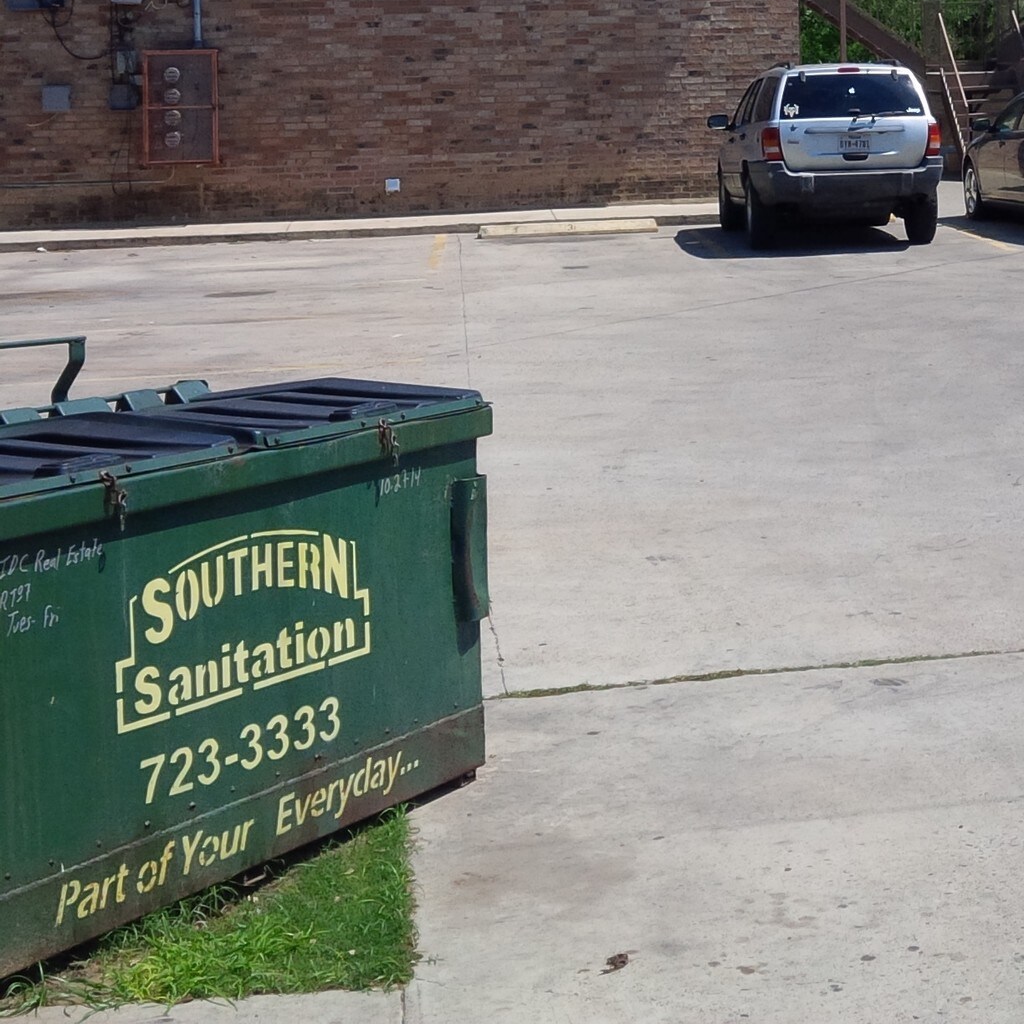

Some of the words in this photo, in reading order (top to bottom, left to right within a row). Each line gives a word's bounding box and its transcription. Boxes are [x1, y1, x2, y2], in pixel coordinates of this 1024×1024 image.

[34, 549, 61, 573] Real
[65, 537, 103, 566] Estate
[141, 533, 349, 645] SOUTHERN
[134, 618, 355, 715] Sanitation
[139, 696, 341, 805] 723-3333
[55, 862, 128, 927] Part
[136, 840, 176, 894] of
[181, 818, 255, 875] Your
